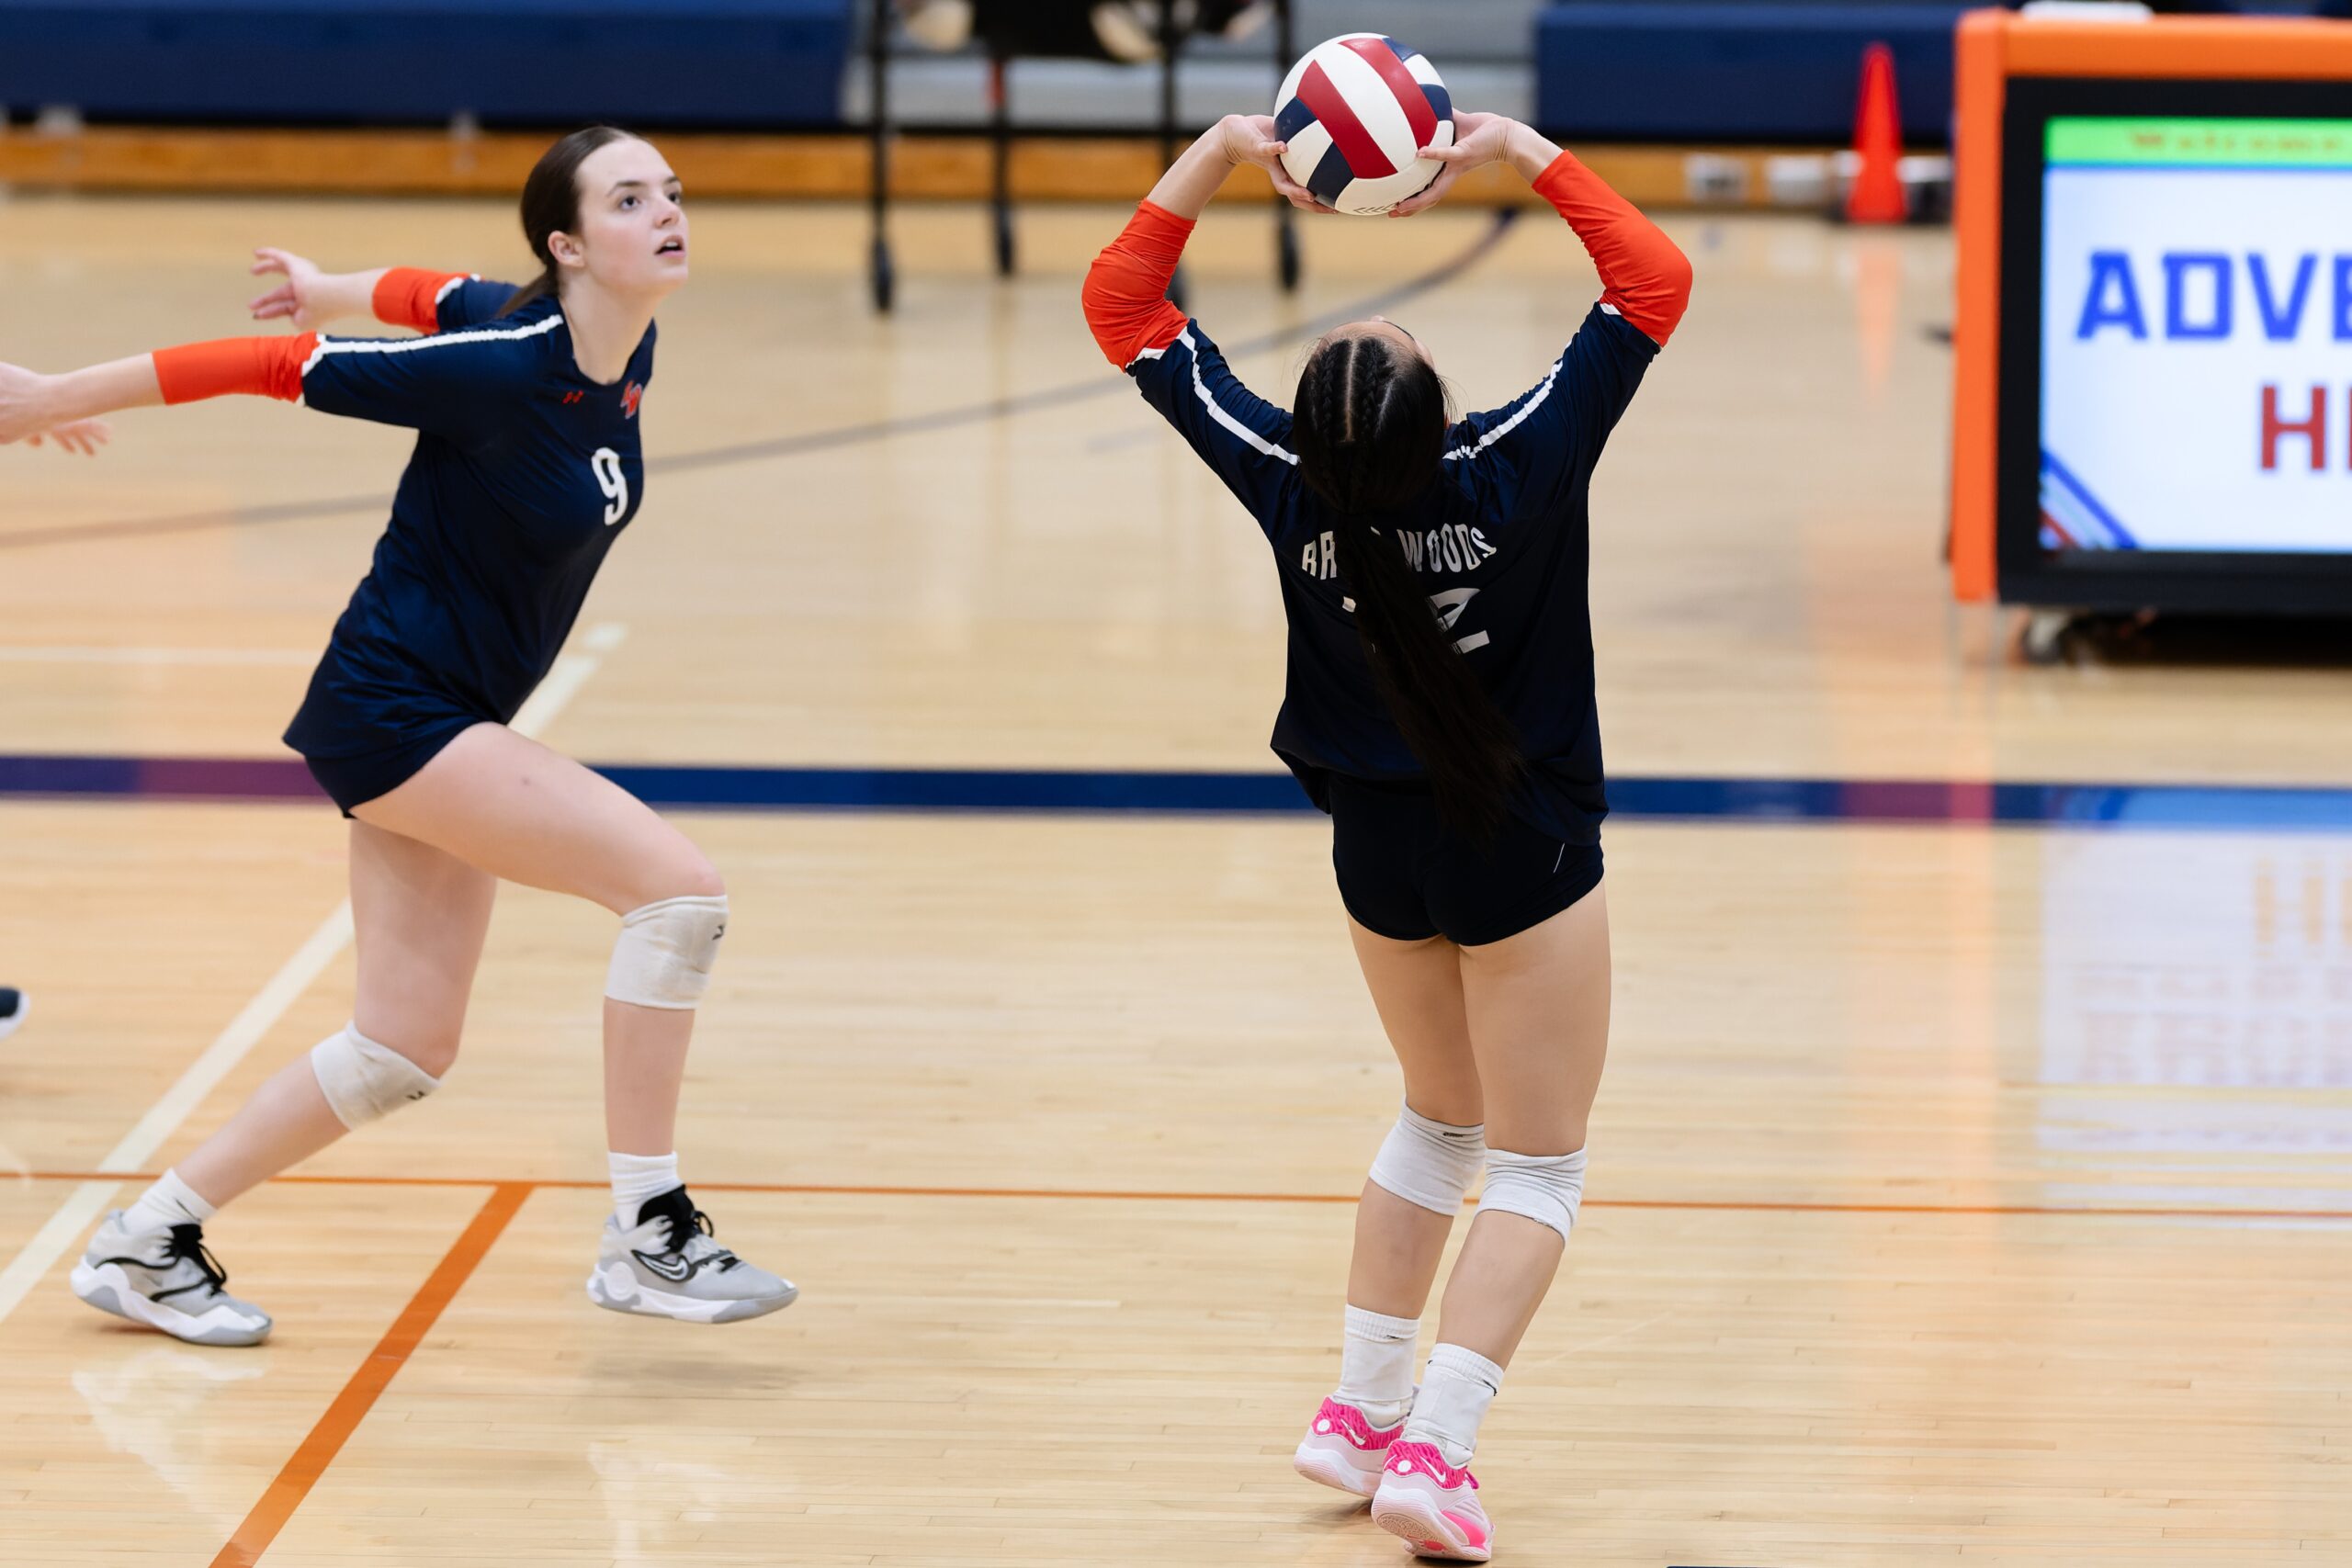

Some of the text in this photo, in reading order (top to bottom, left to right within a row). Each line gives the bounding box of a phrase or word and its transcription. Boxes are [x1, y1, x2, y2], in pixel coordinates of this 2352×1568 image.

[2260, 385, 2352, 470] H
[592, 446, 628, 526] 9
[1396, 523, 1498, 573] WOODS
